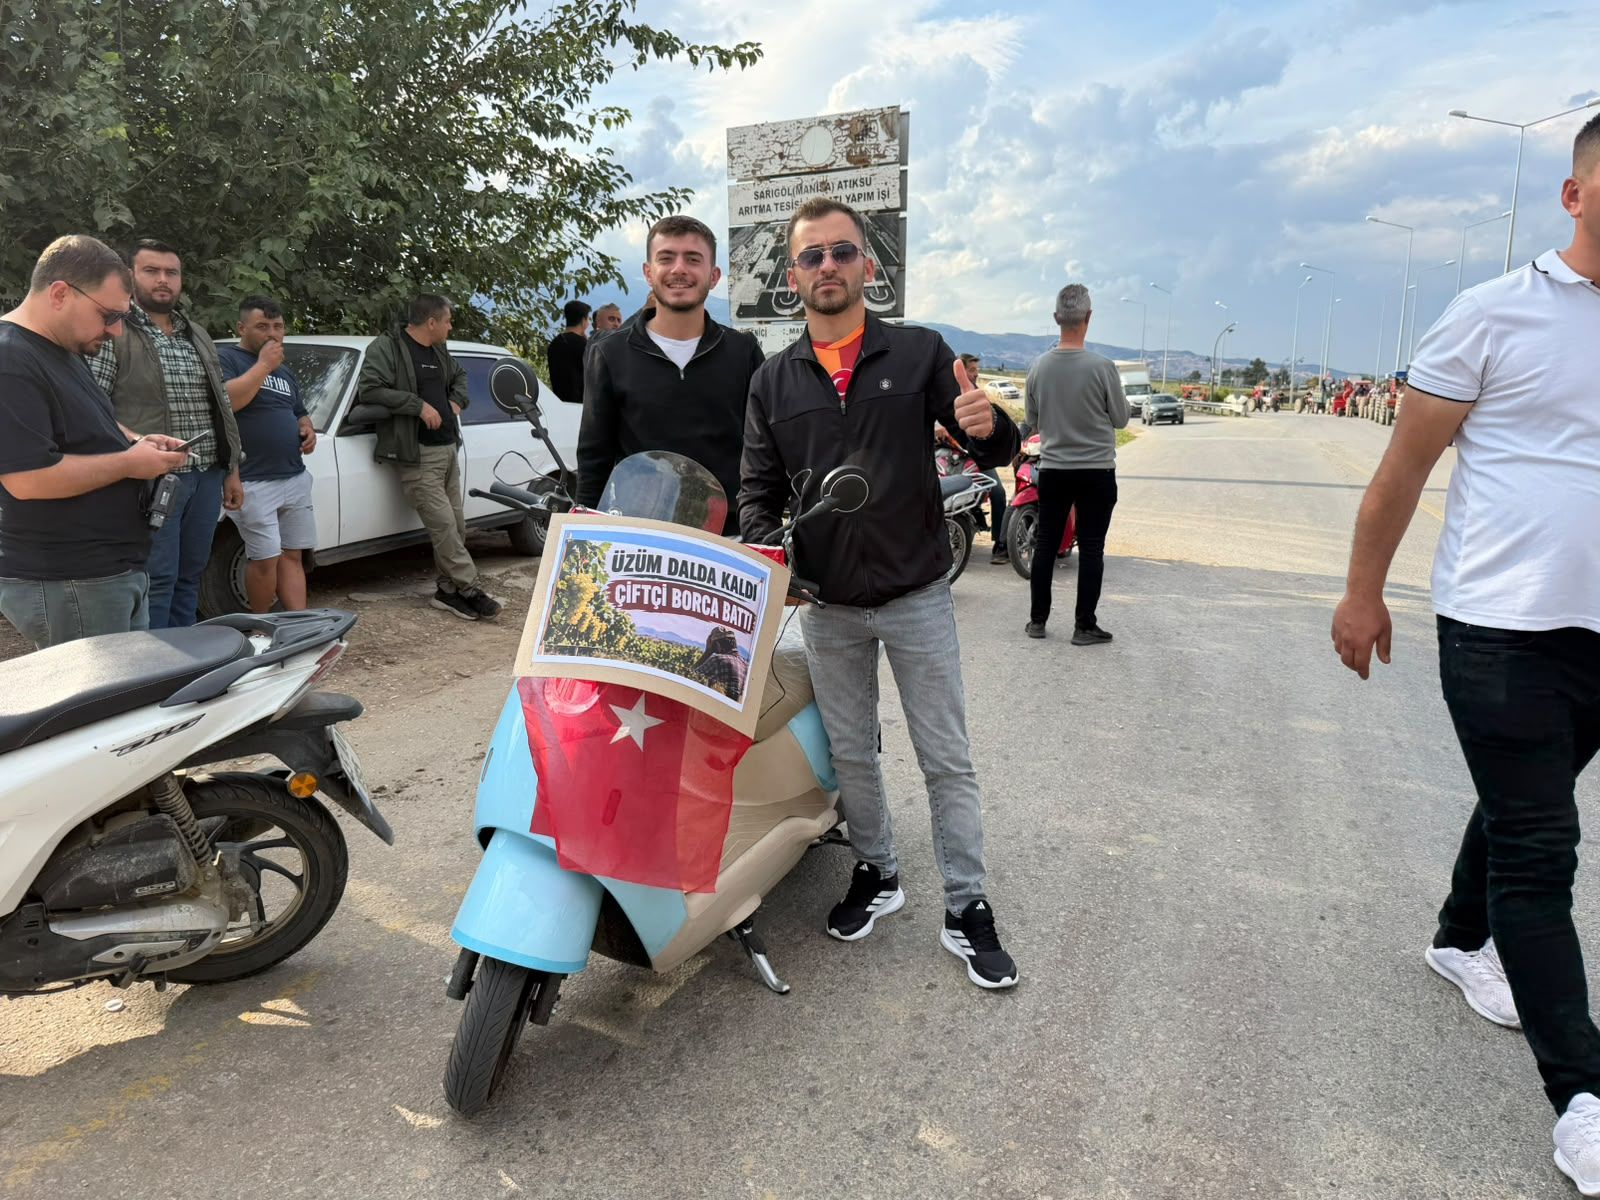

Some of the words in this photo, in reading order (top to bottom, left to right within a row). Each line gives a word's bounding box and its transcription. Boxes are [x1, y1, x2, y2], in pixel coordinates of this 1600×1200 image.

[837, 176, 872, 190] ATIKSU
[738, 203, 772, 217] ARITMA
[845, 191, 874, 203] YAPIM
[611, 549, 662, 573] ÜZÜM
[667, 557, 717, 586] DALDA
[721, 571, 758, 602] KALDI
[615, 581, 667, 609] ÇİFTÇİ
[671, 588, 720, 619] BORCA
